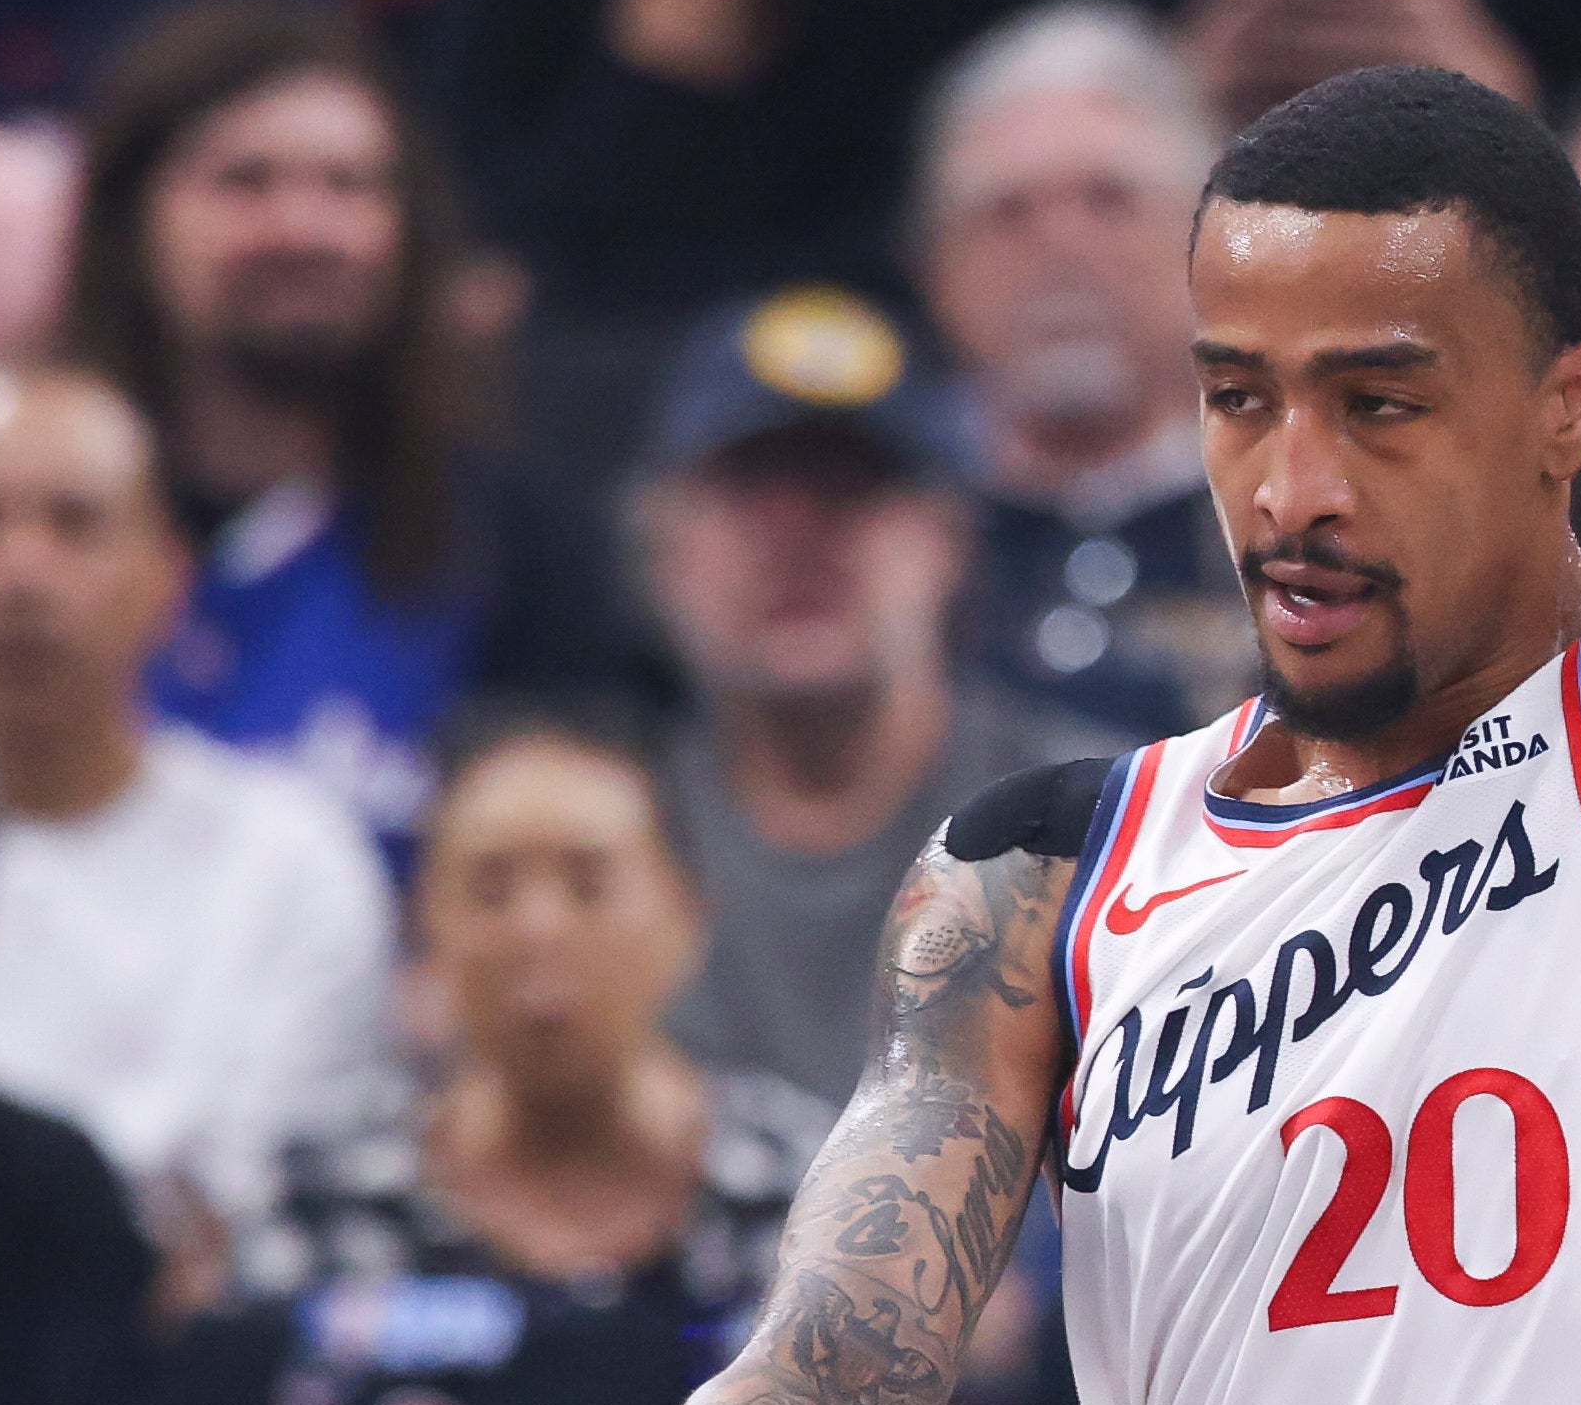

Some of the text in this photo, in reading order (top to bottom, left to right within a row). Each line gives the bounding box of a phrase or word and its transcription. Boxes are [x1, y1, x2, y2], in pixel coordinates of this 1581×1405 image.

[1435, 732, 1550, 787] ANDA
[1463, 714, 1512, 750] SIT
[1267, 1067, 1570, 1332] 20
